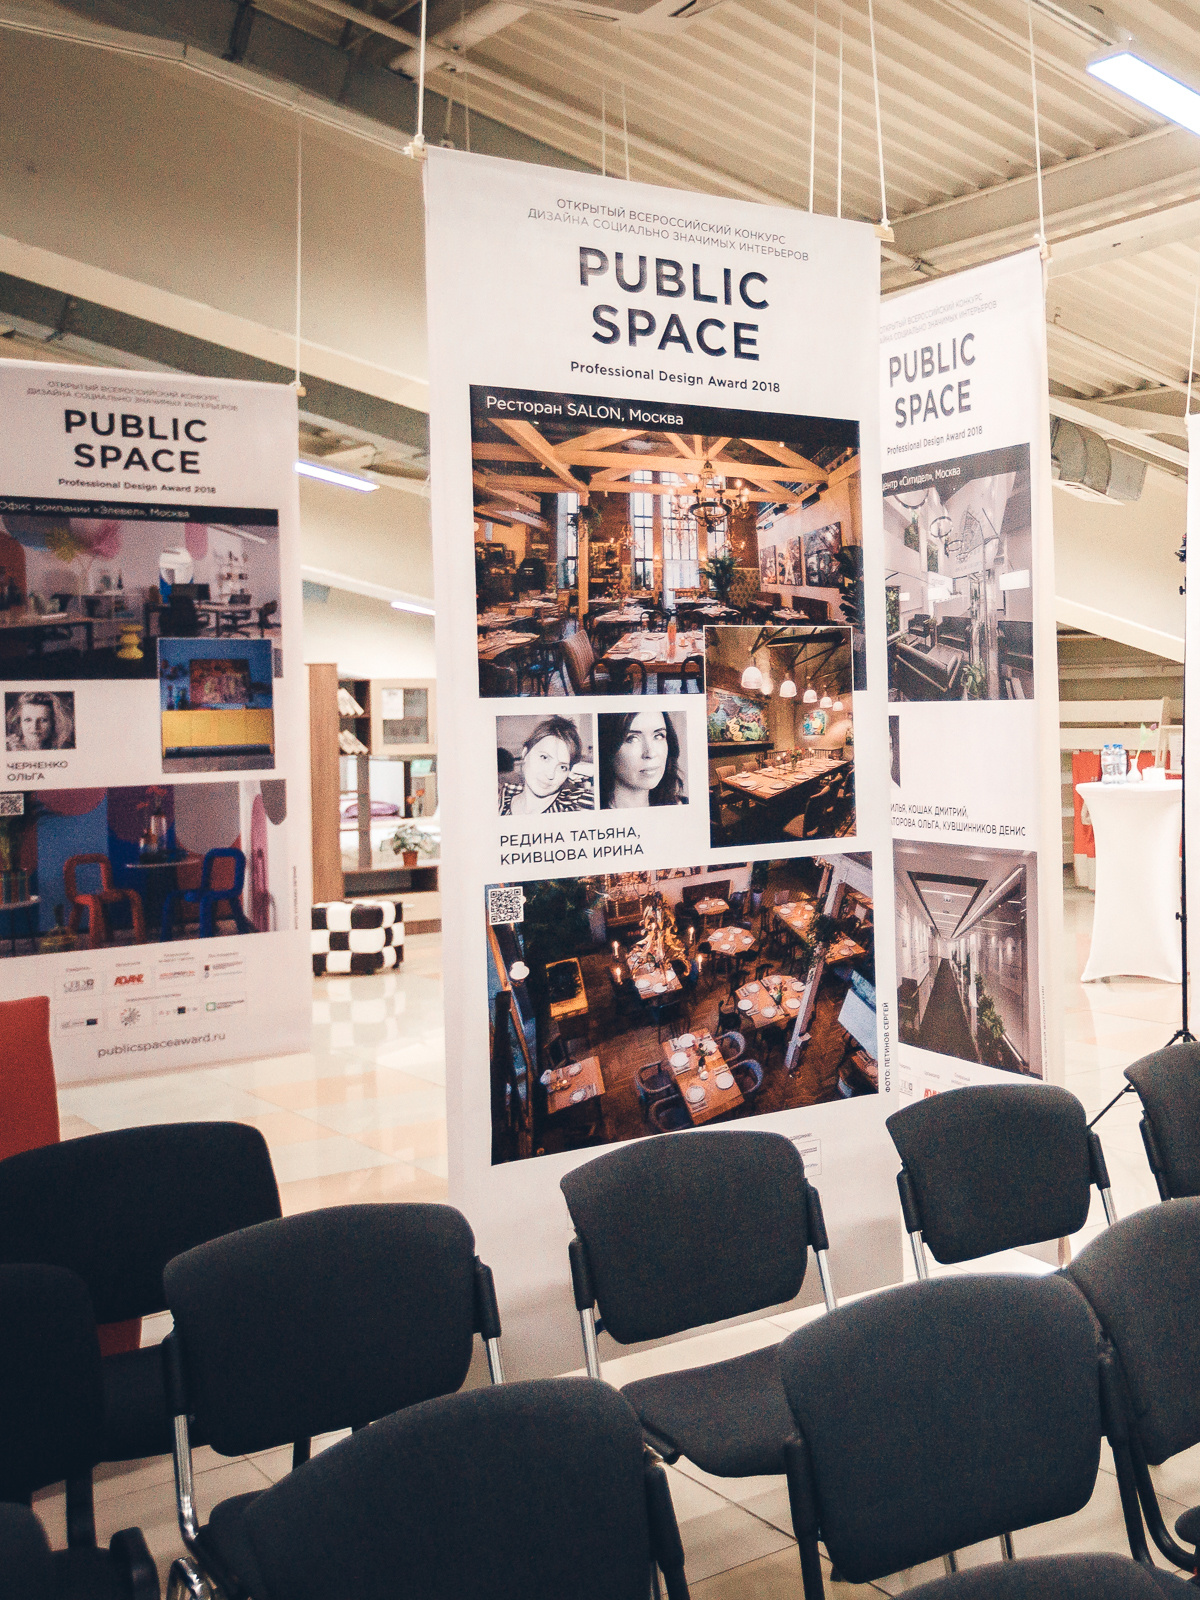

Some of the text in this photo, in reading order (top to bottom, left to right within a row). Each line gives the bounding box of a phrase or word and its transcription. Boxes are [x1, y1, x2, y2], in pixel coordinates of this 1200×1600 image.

[528, 207, 809, 261] ДИЗАЙНА СОЦИАЛЬНО ЗНАЧИМЫХ ИНТЕРЬЕРОВ
[556, 197, 786, 245] ОТКРЫТЫЙ ВСЕРОССИЙСКИЙ КОНКУРС
[579, 246, 770, 310] PUBLIC
[592, 304, 760, 361] SPACE
[889, 332, 976, 388] PUBLIC
[570, 361, 780, 393] Professional Design Award 2018
[486, 396, 684, 425] Ресторан SALON, Москва
[895, 379, 971, 428] SPACE
[65, 409, 207, 443] PUBLIC
[887, 425, 982, 455] Professional Design Award 2018
[74, 443, 200, 474] SPACE
[935, 467, 960, 479] Москва
[58, 478, 216, 494] Professional Design Award 2018
[35, 504, 91, 514] компании
[150, 508, 190, 518] Москва
[7, 760, 68, 769] ЧЕРНЕНКО
[7, 773, 44, 781] ОЛЬГА
[909, 805, 932, 814] КОШАК
[935, 805, 968, 819] ДМИТРИЙ,
[500, 827, 641, 847] РЕДИНА ТАТЬЯНА,
[918, 819, 941, 831] ОЛЬГА,
[943, 821, 996, 834] КУВШИННИКОВ
[999, 825, 1026, 836] ДЕНИС
[500, 844, 644, 865] КРИВЦОВА ИРИНА
[98, 1032, 226, 1058] publicspaceaward.ru
